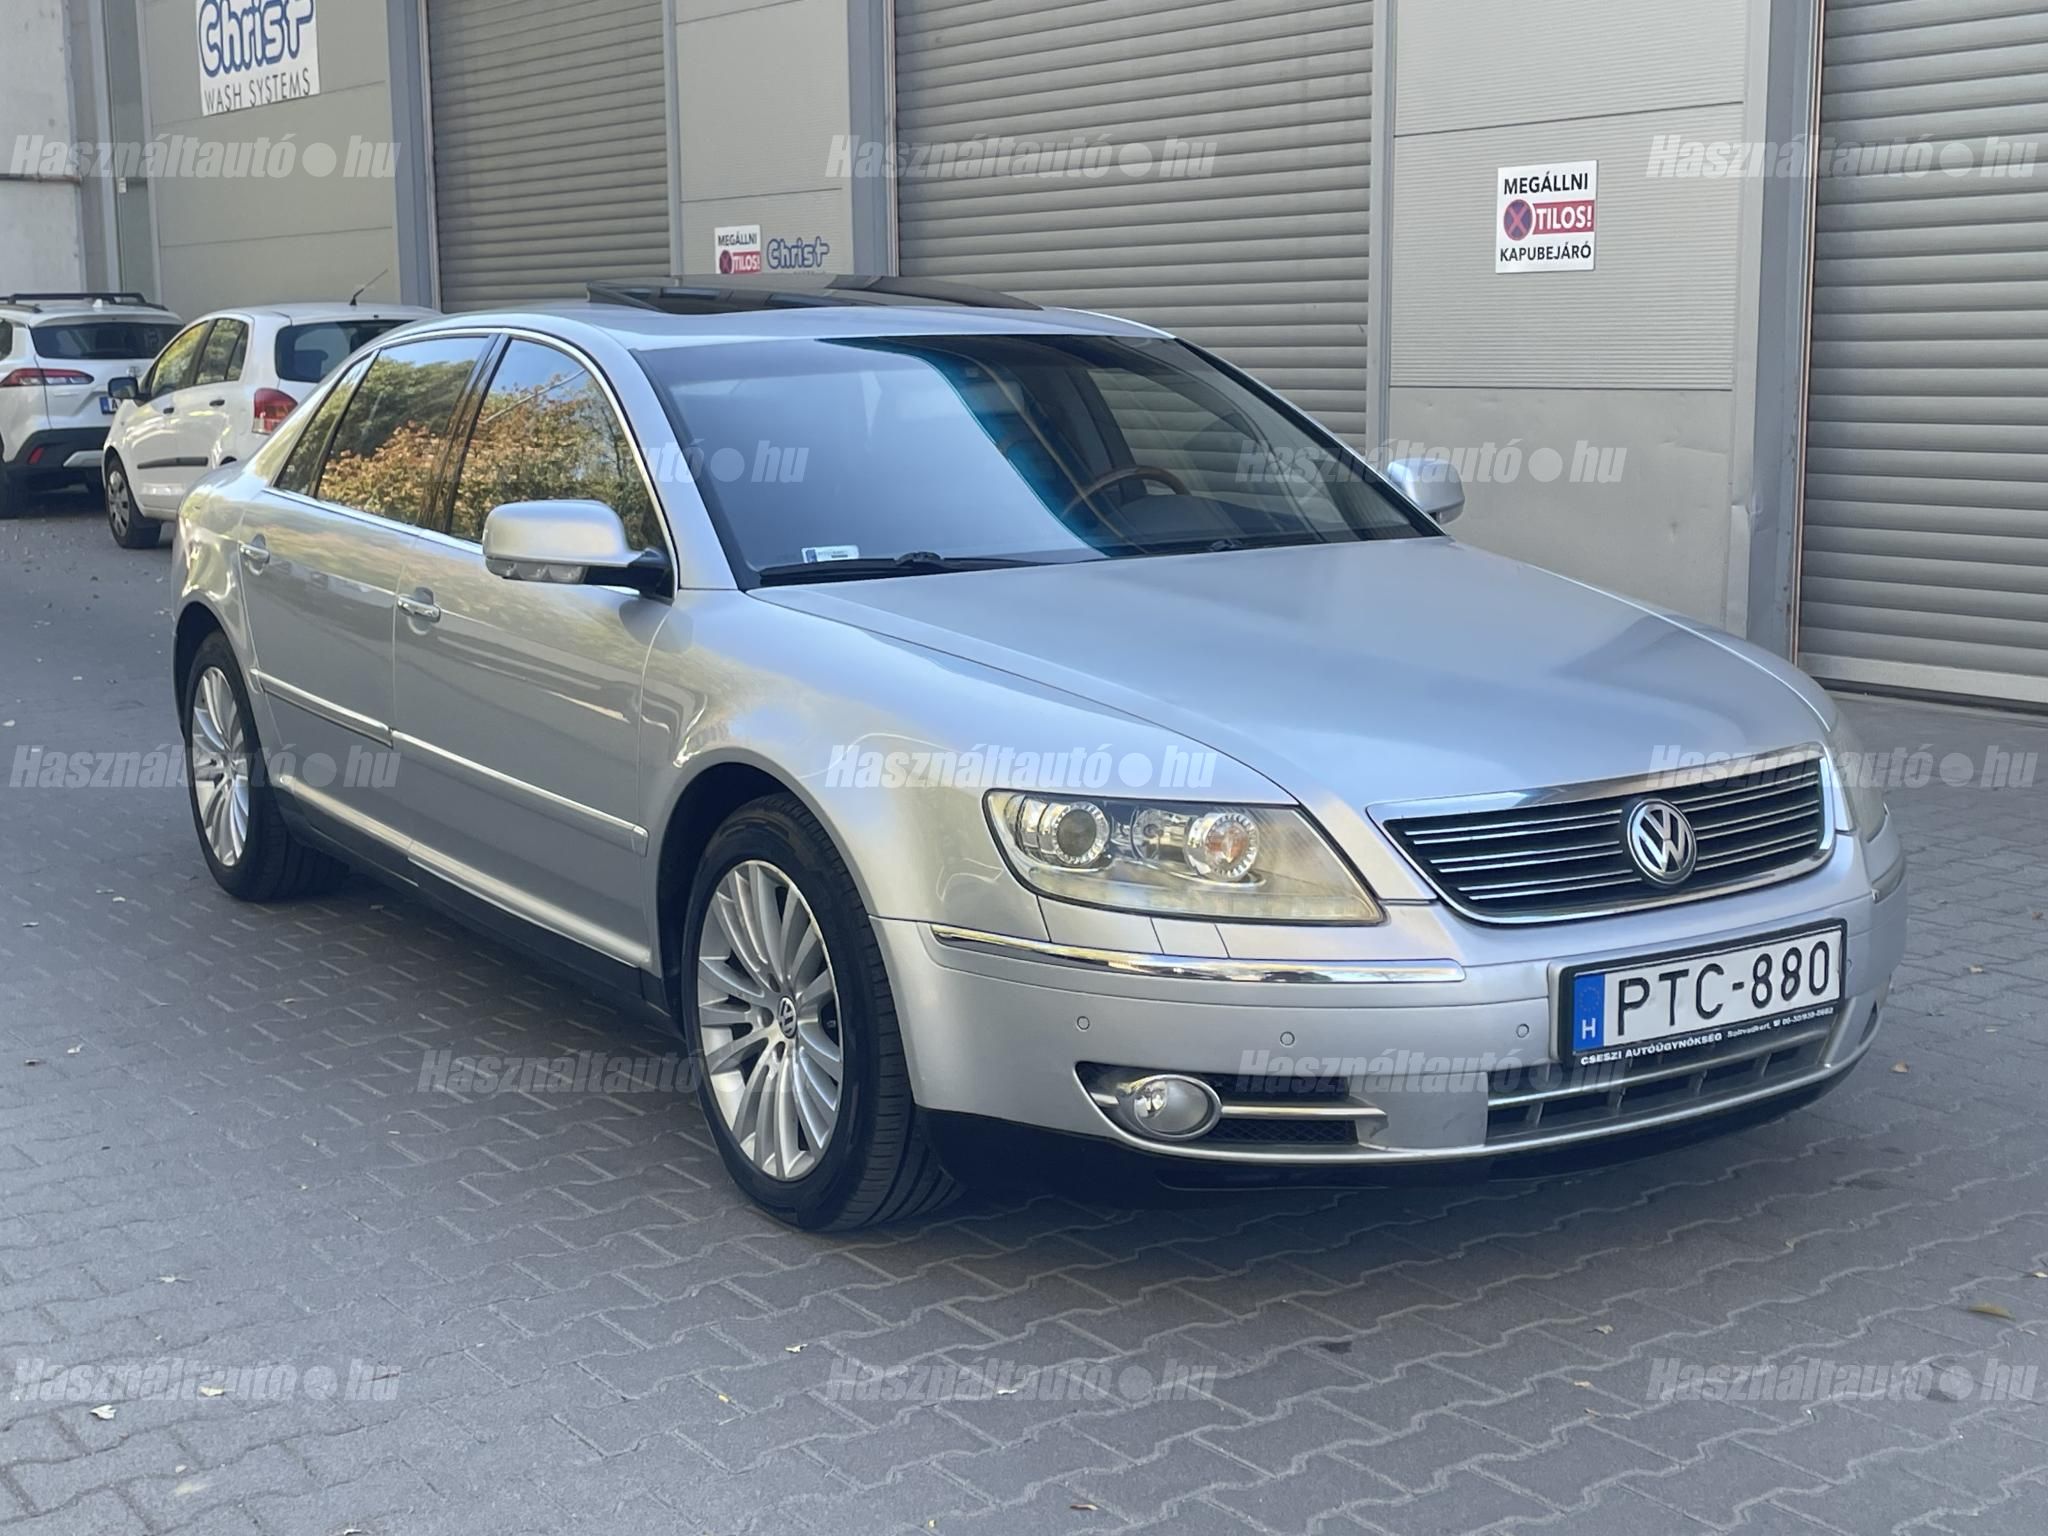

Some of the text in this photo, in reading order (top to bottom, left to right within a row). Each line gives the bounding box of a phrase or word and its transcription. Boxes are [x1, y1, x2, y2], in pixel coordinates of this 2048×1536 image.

[199, 0, 314, 77] Christ
[204, 67, 311, 113] WASH SYSTEMS
[1503, 171, 1589, 195] MEGÁLLNI
[1536, 205, 1593, 231] TILOS!
[718, 231, 757, 247] MEGÁLLNI
[1500, 241, 1592, 262] KAPUBEJÁRÓ
[766, 236, 830, 270] Christ
[1617, 940, 1830, 1036] PTC-880
[1582, 1018, 1596, 1040] H
[1580, 1050, 1622, 1065] CSESZI
